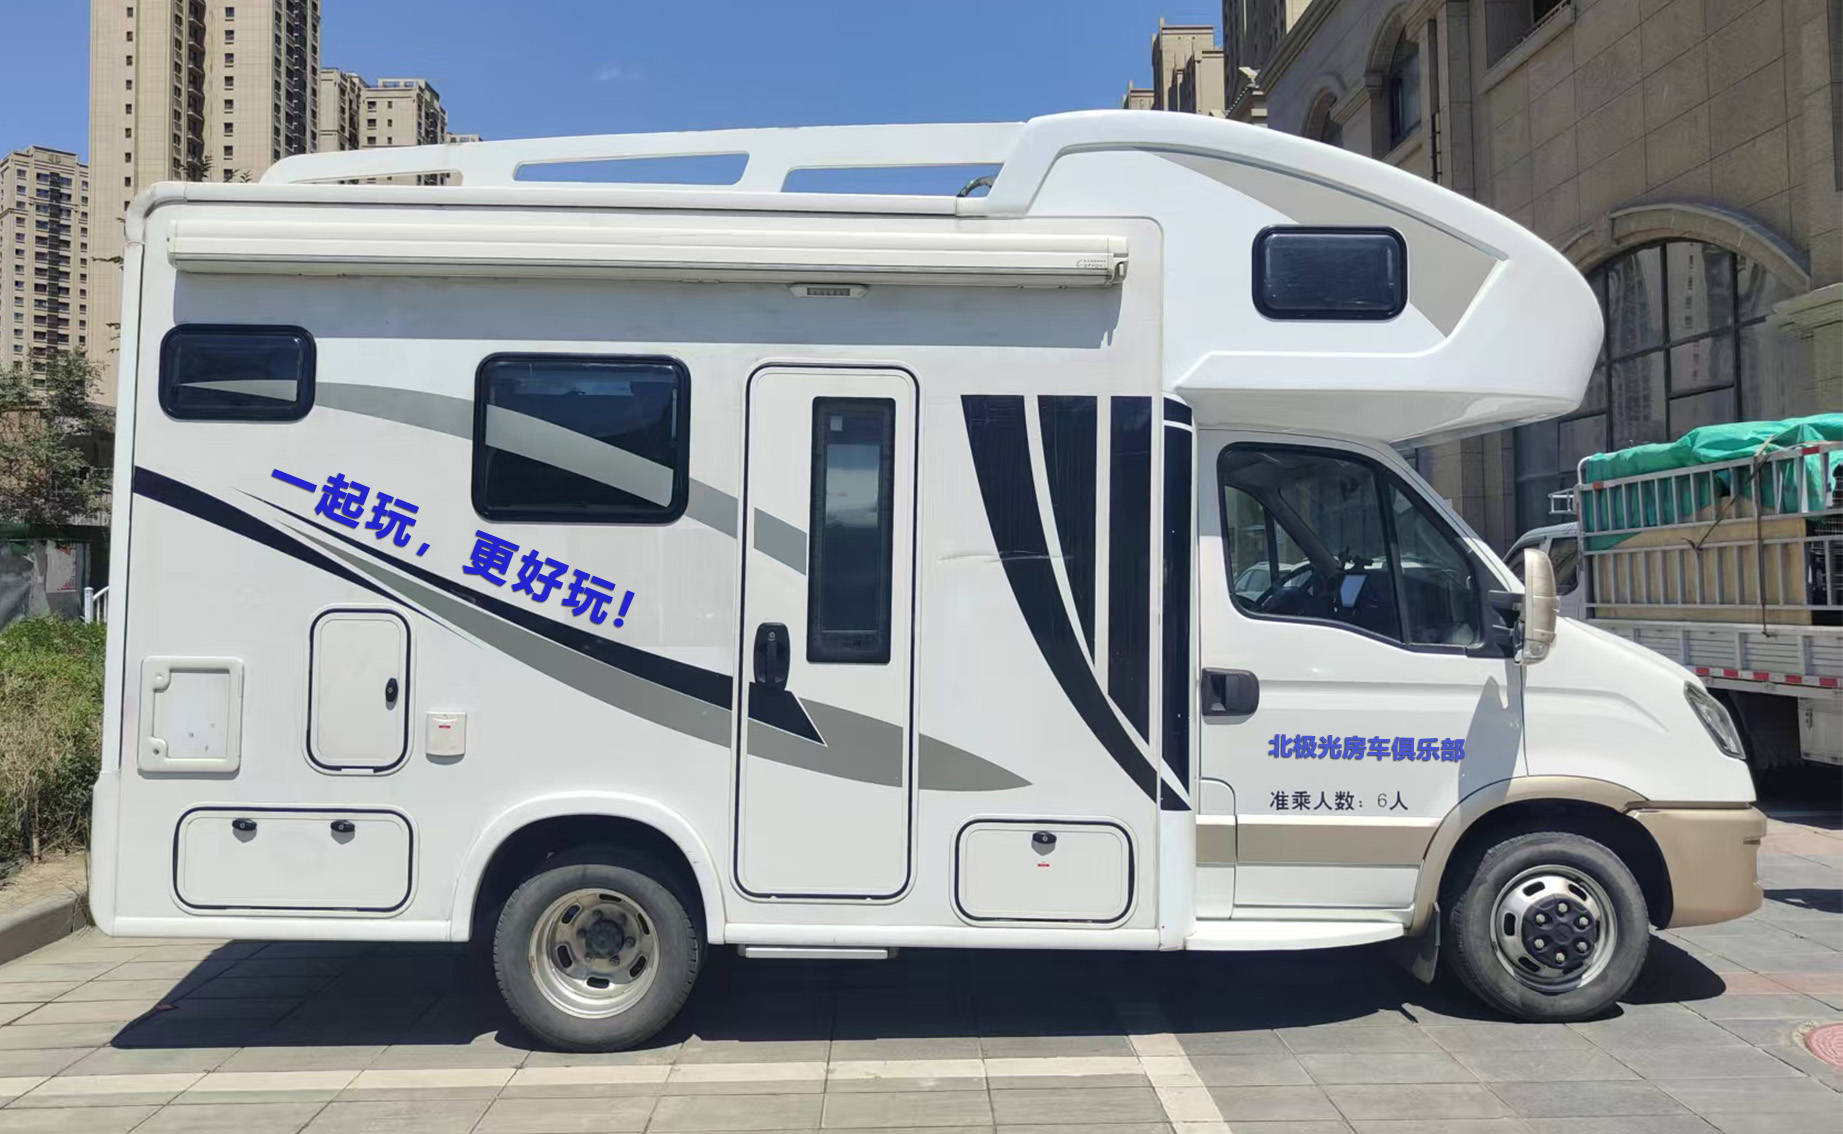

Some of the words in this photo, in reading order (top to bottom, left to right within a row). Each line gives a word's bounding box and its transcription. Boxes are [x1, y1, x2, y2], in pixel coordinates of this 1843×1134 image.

[1268, 733, 1466, 763] 北极光房车俱乐部
[1269, 790, 1409, 811] 准乘人数：6人
